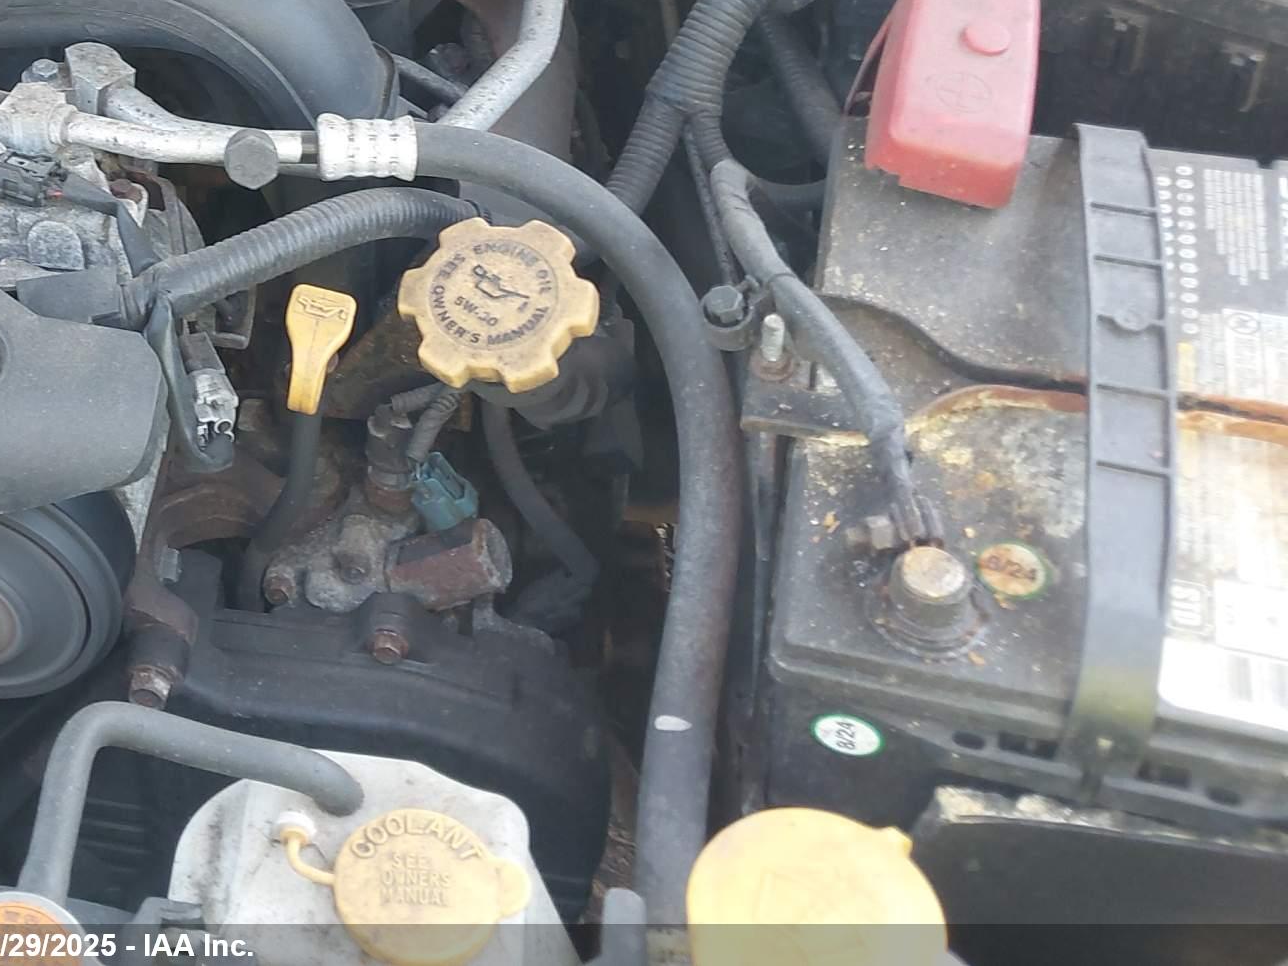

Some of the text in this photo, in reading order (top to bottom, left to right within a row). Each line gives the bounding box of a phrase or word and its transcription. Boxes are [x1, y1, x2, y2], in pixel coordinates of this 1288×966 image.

[536, 269, 553, 294] OIL
[438, 253, 466, 280] SEE
[487, 305, 550, 345] MANUAL
[834, 720, 857, 751] 8/24
[350, 813, 484, 860] COOLANT
[391, 852, 432, 870] SEE
[381, 870, 451, 888] OWNERS
[380, 888, 449, 907] MANUAL
